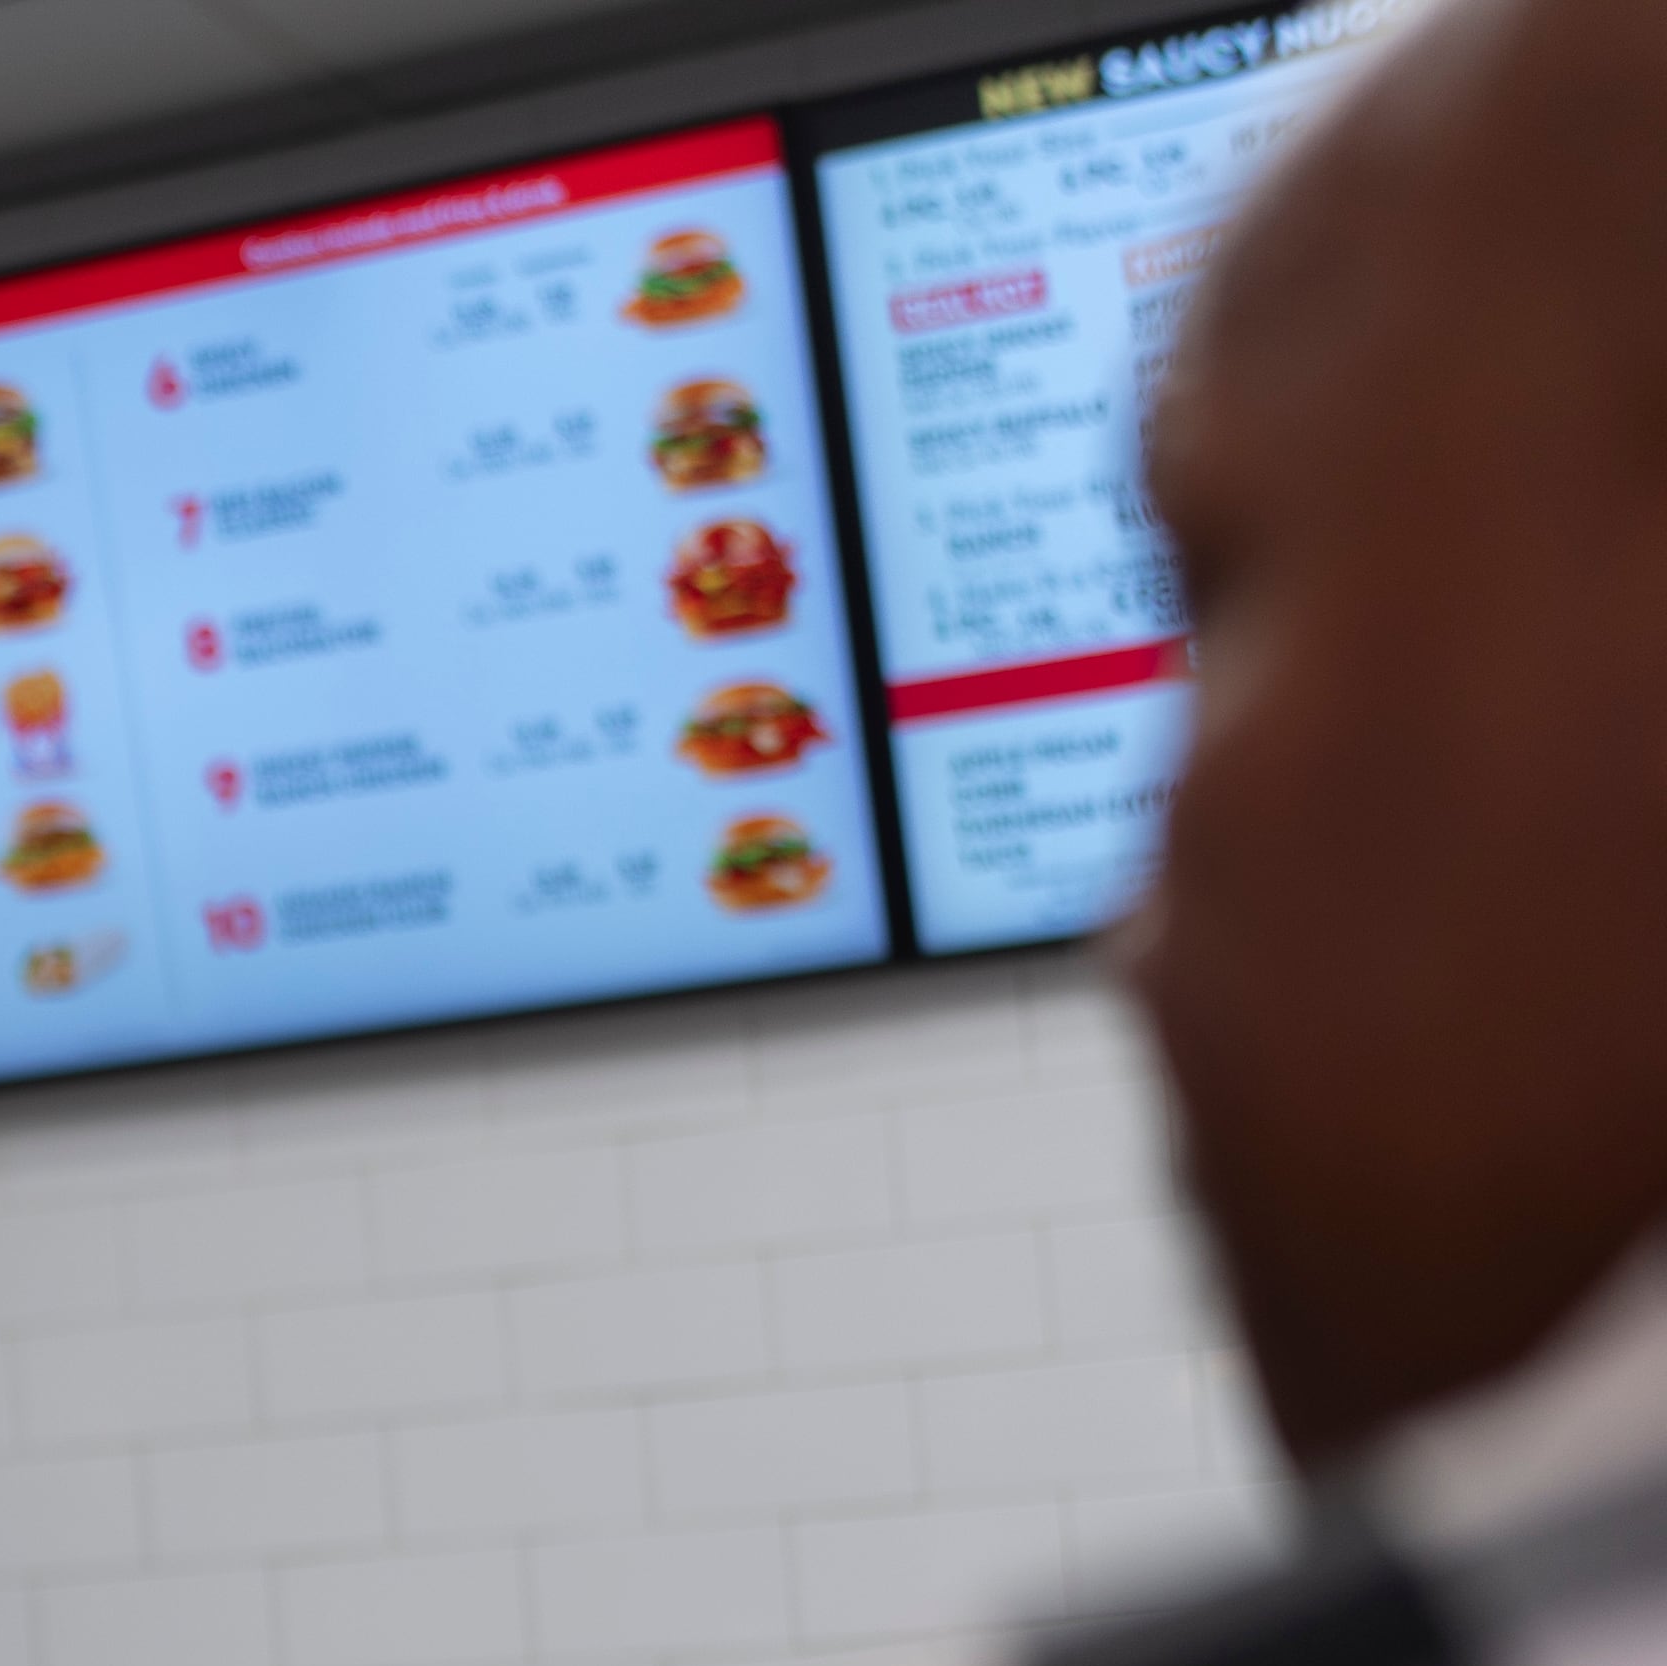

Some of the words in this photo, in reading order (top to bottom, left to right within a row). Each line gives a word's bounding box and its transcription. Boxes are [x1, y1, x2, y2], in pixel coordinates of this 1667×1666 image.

[978, 54, 1095, 119] NEW
[1099, 18, 1267, 97] SAUCY
[203, 898, 265, 952] 10
